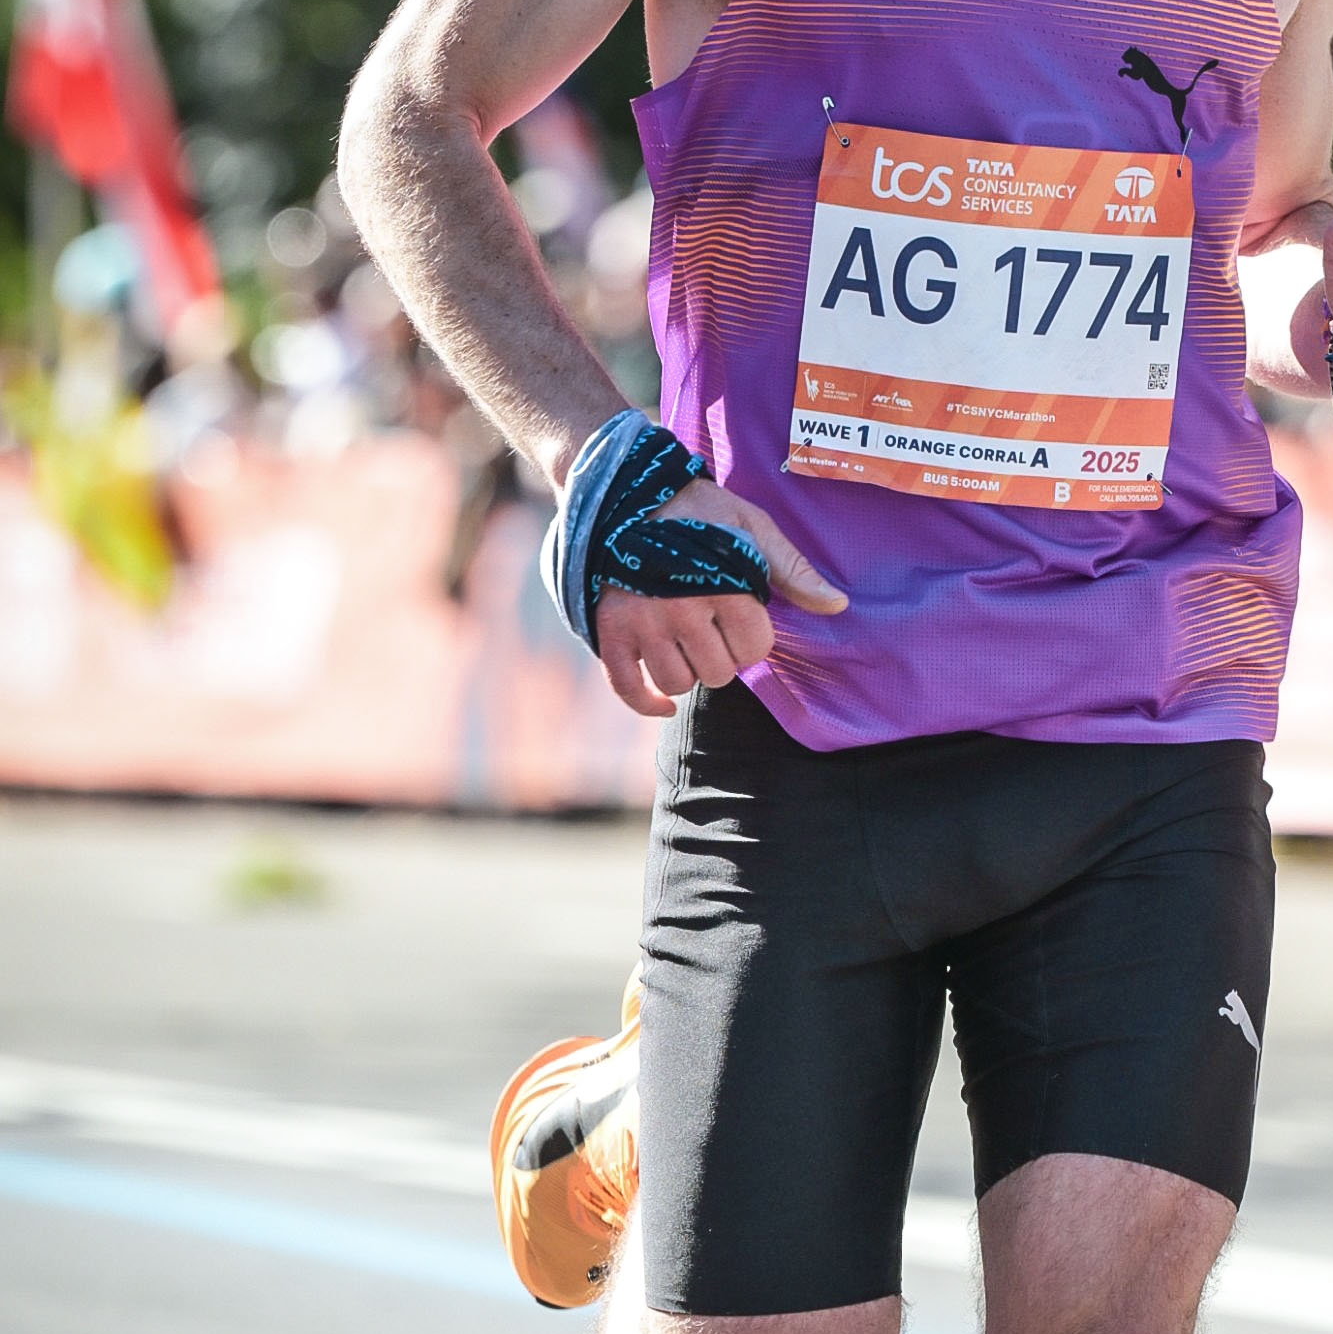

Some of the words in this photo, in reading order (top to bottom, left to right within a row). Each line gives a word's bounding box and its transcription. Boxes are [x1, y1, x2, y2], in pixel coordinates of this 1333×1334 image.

[872, 147, 954, 206] tcs
[967, 159, 1014, 177] TATA
[963, 176, 1076, 200] CONSULTANCY
[961, 195, 1033, 215] SERVICES
[1105, 204, 1156, 223] TATA
[820, 227, 958, 324] AG
[994, 246, 1170, 341] 1774
[946, 402, 1055, 423] #TCSNYCMarathon
[799, 418, 851, 441] WAVE
[857, 425, 869, 447] 1
[885, 434, 956, 457] ORANGE
[959, 444, 1027, 464] CORRAL
[1030, 448, 1049, 468] A
[1081, 450, 1140, 473] 2025
[924, 472, 949, 486] BUS
[950, 476, 1000, 492] 5:00AM
[1054, 482, 1070, 503] B
